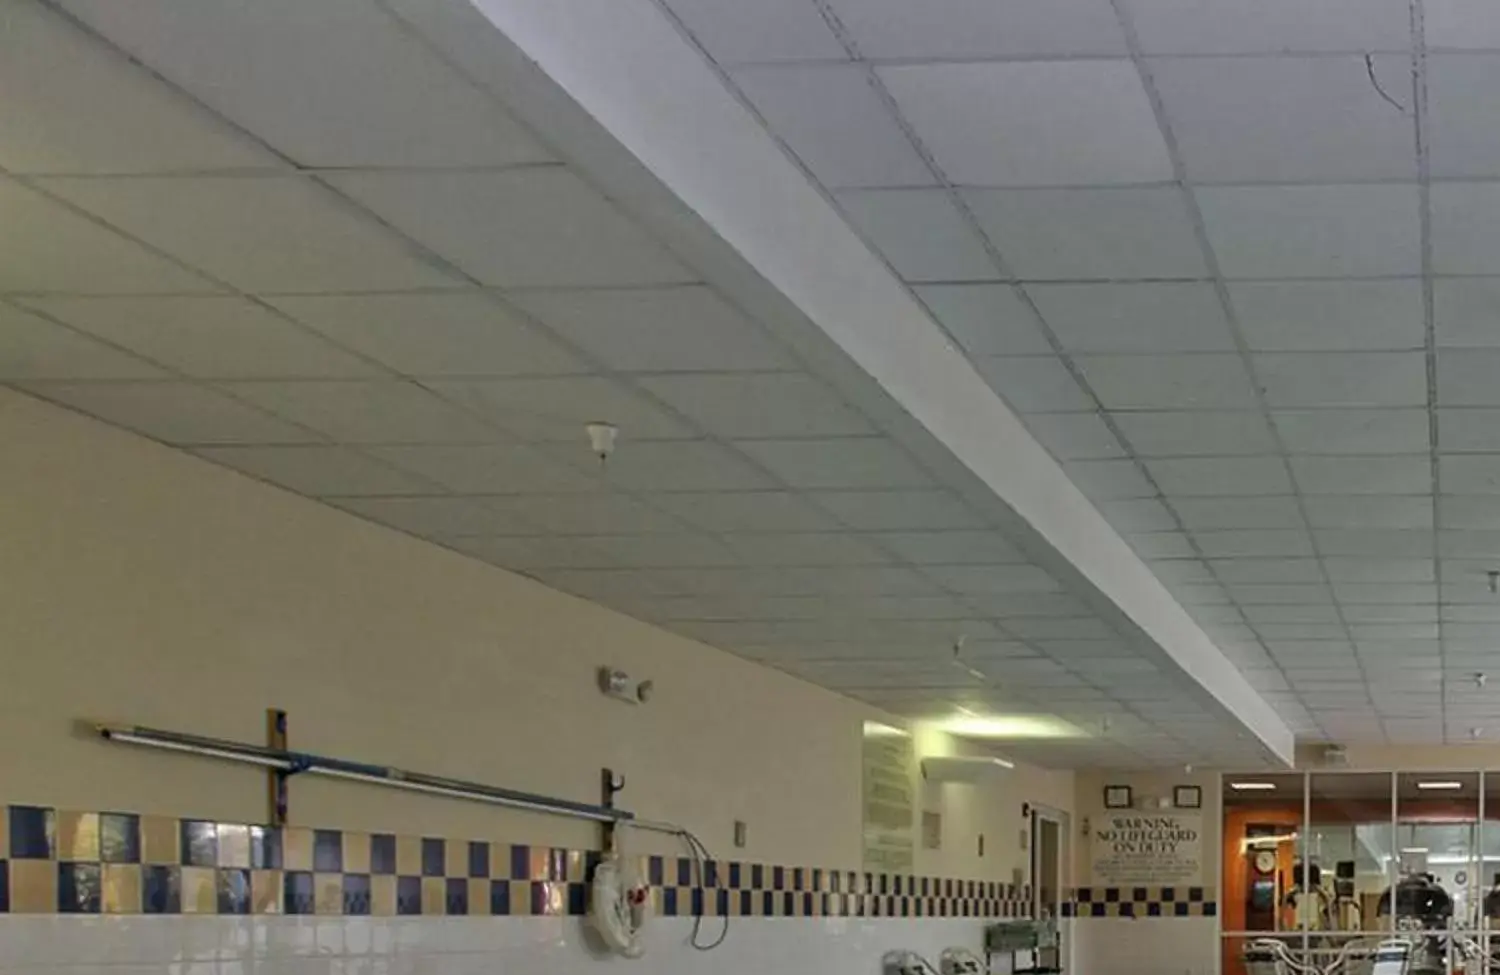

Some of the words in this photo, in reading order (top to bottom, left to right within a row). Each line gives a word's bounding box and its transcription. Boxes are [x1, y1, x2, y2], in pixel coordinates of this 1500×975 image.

[1097, 830, 1118, 841] NO
[1120, 830, 1198, 841] LIFEGUARD
[1113, 842, 1136, 853] ON
[1139, 842, 1177, 853] DUTY
